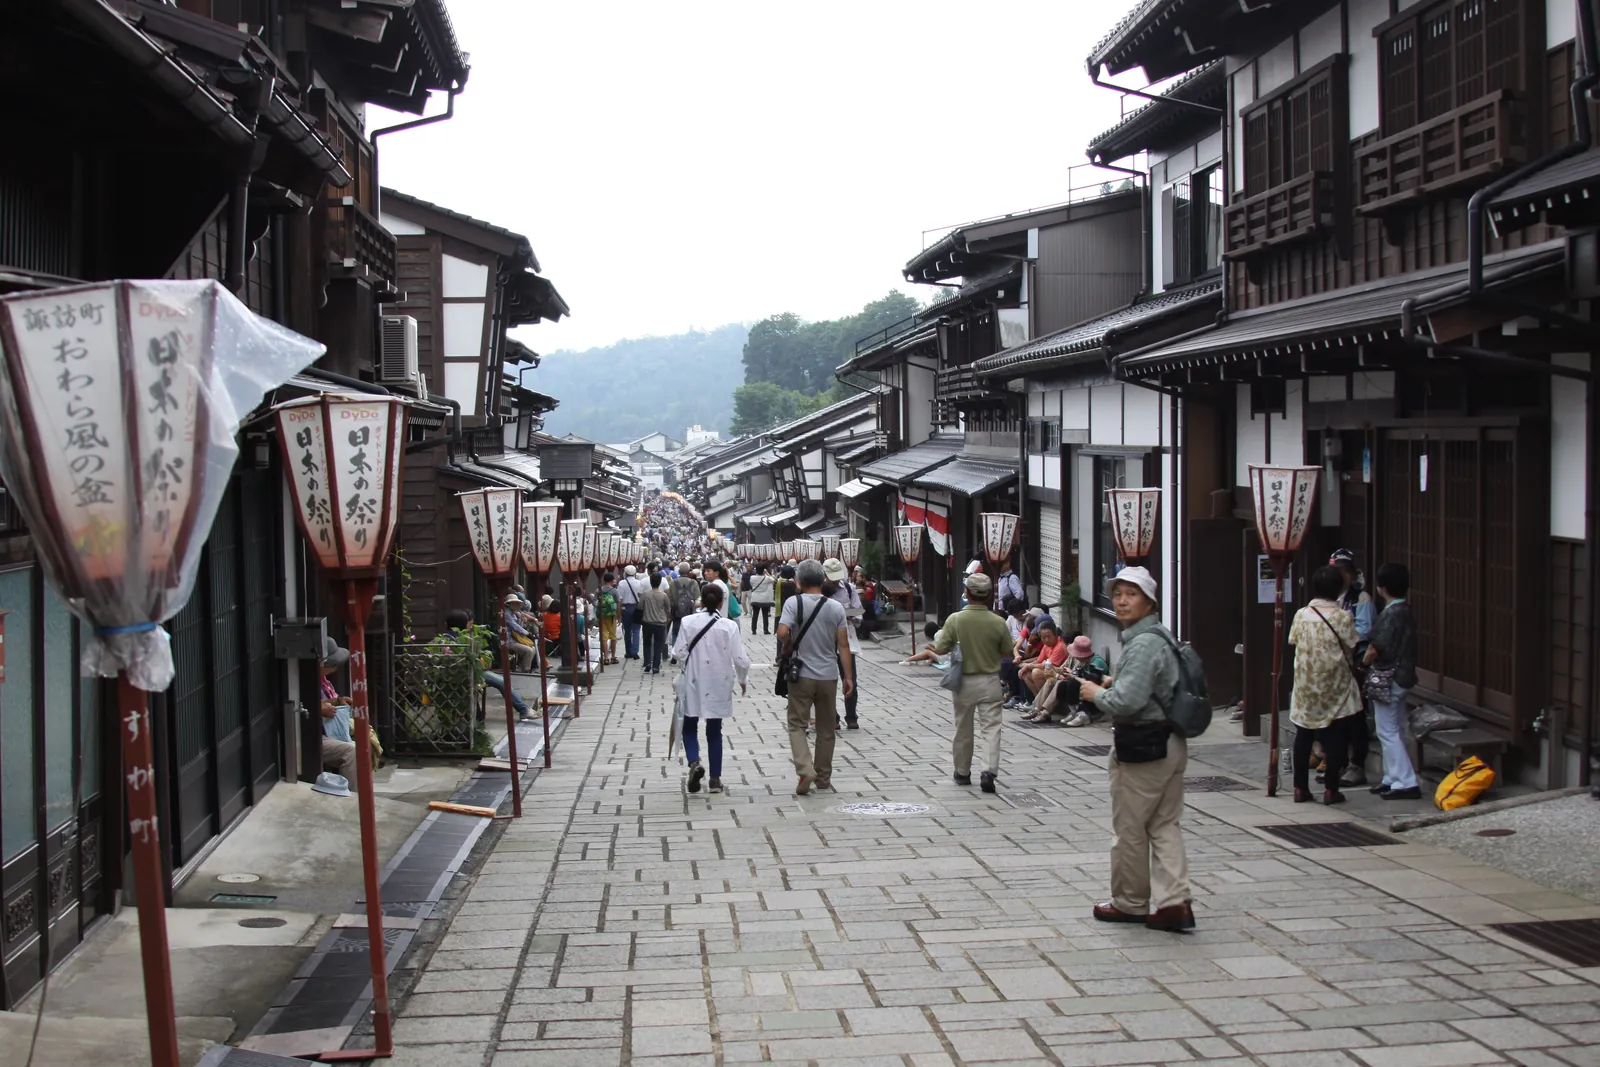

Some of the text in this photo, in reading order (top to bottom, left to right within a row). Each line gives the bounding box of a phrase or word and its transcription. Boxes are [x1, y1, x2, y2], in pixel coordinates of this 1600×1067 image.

[52, 336, 115, 507] おわら風の盆
[289, 411, 316, 422] DyDo
[341, 410, 378, 420] DyDo
[296, 426, 331, 549] 日本の祭り
[345, 426, 377, 550] 日本の祭り
[1268, 480, 1285, 541] 日本の祭り
[1291, 482, 1308, 540] 日本の祭り
[471, 505, 491, 566] 日本の祭り
[496, 502, 511, 564] 日本の祭り
[540, 515, 552, 564] 日本の祭り
[1122, 501, 1136, 550] 日本の祭り
